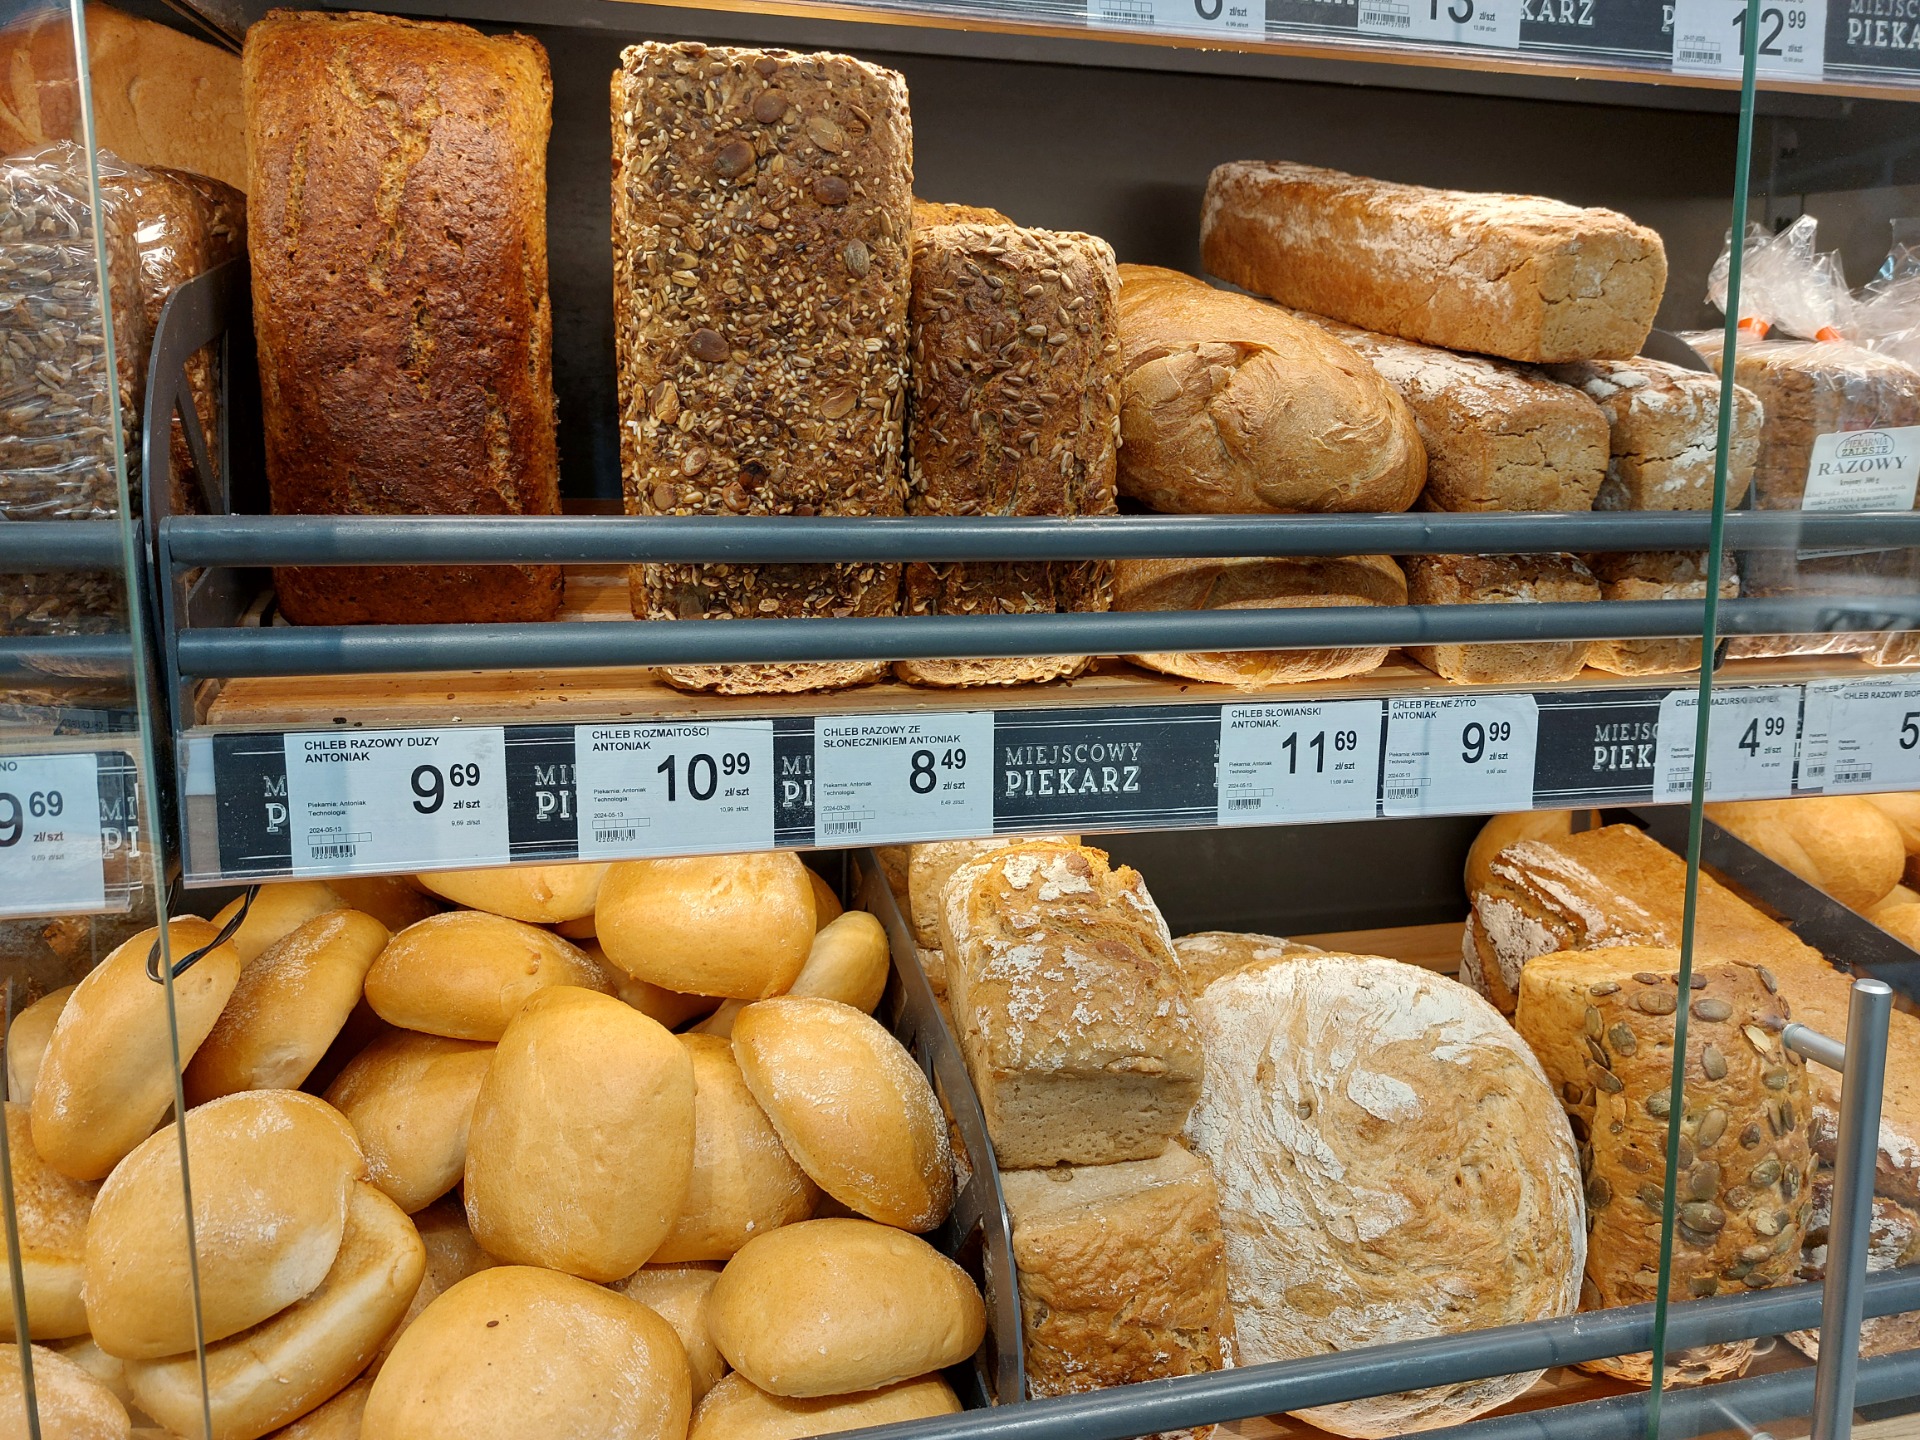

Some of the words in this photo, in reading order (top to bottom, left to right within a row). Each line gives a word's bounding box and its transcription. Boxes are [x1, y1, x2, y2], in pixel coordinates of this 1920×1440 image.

[1788, 10, 1806, 29] 99
[1844, 437, 1888, 448] PIEKARNIA
[1842, 446, 1889, 457] ZALESIE
[1817, 456, 1908, 476] RAZOWY
[1392, 700, 1422, 709] CHLEB
[1424, 700, 1452, 709] PEŁNE
[1454, 698, 1477, 708] ŻYTO
[1844, 692, 1869, 700] CHLEB
[1870, 691, 1903, 699] RAZOWY
[1231, 709, 1263, 718] CHLEB
[1265, 706, 1322, 717] SŁOWIAŃSKI
[1392, 710, 1437, 720] ANTONIAK
[592, 729, 631, 740] CHLEB
[634, 727, 710, 739] ROZMAITOŚCI
[823, 728, 859, 737] CHLEB
[861, 726, 906, 736] RAZOWY
[908, 725, 921, 734] ZE
[1738, 718, 1760, 758] 4
[1765, 716, 1785, 737] 99
[1899, 712, 1920, 750] 5
[304, 740, 347, 750] CHLEB
[350, 738, 404, 749] RAZOWY
[407, 736, 440, 747] DUZY
[592, 741, 651, 752] ANTONIAK
[824, 737, 907, 748] SŁONECZNIKIEM
[909, 735, 961, 744] ANTONIAK
[1462, 722, 1485, 764] 9
[1489, 721, 1511, 742] 99
[305, 752, 370, 763] ANTONIAK
[1005, 742, 1142, 766] MIEJSCOWY
[1282, 731, 1325, 774] 11
[1334, 730, 1357, 752] 69
[1592, 744, 1656, 770] PIEK
[657, 753, 718, 802] 10
[722, 752, 750, 776] 99
[909, 749, 937, 794] 8
[941, 748, 967, 770] 49
[410, 764, 444, 815] 9
[450, 762, 480, 788] 69
[1005, 766, 1140, 797] PIEKARZ
[29, 790, 64, 818] 69
[309, 826, 342, 834] 2024-05-13
